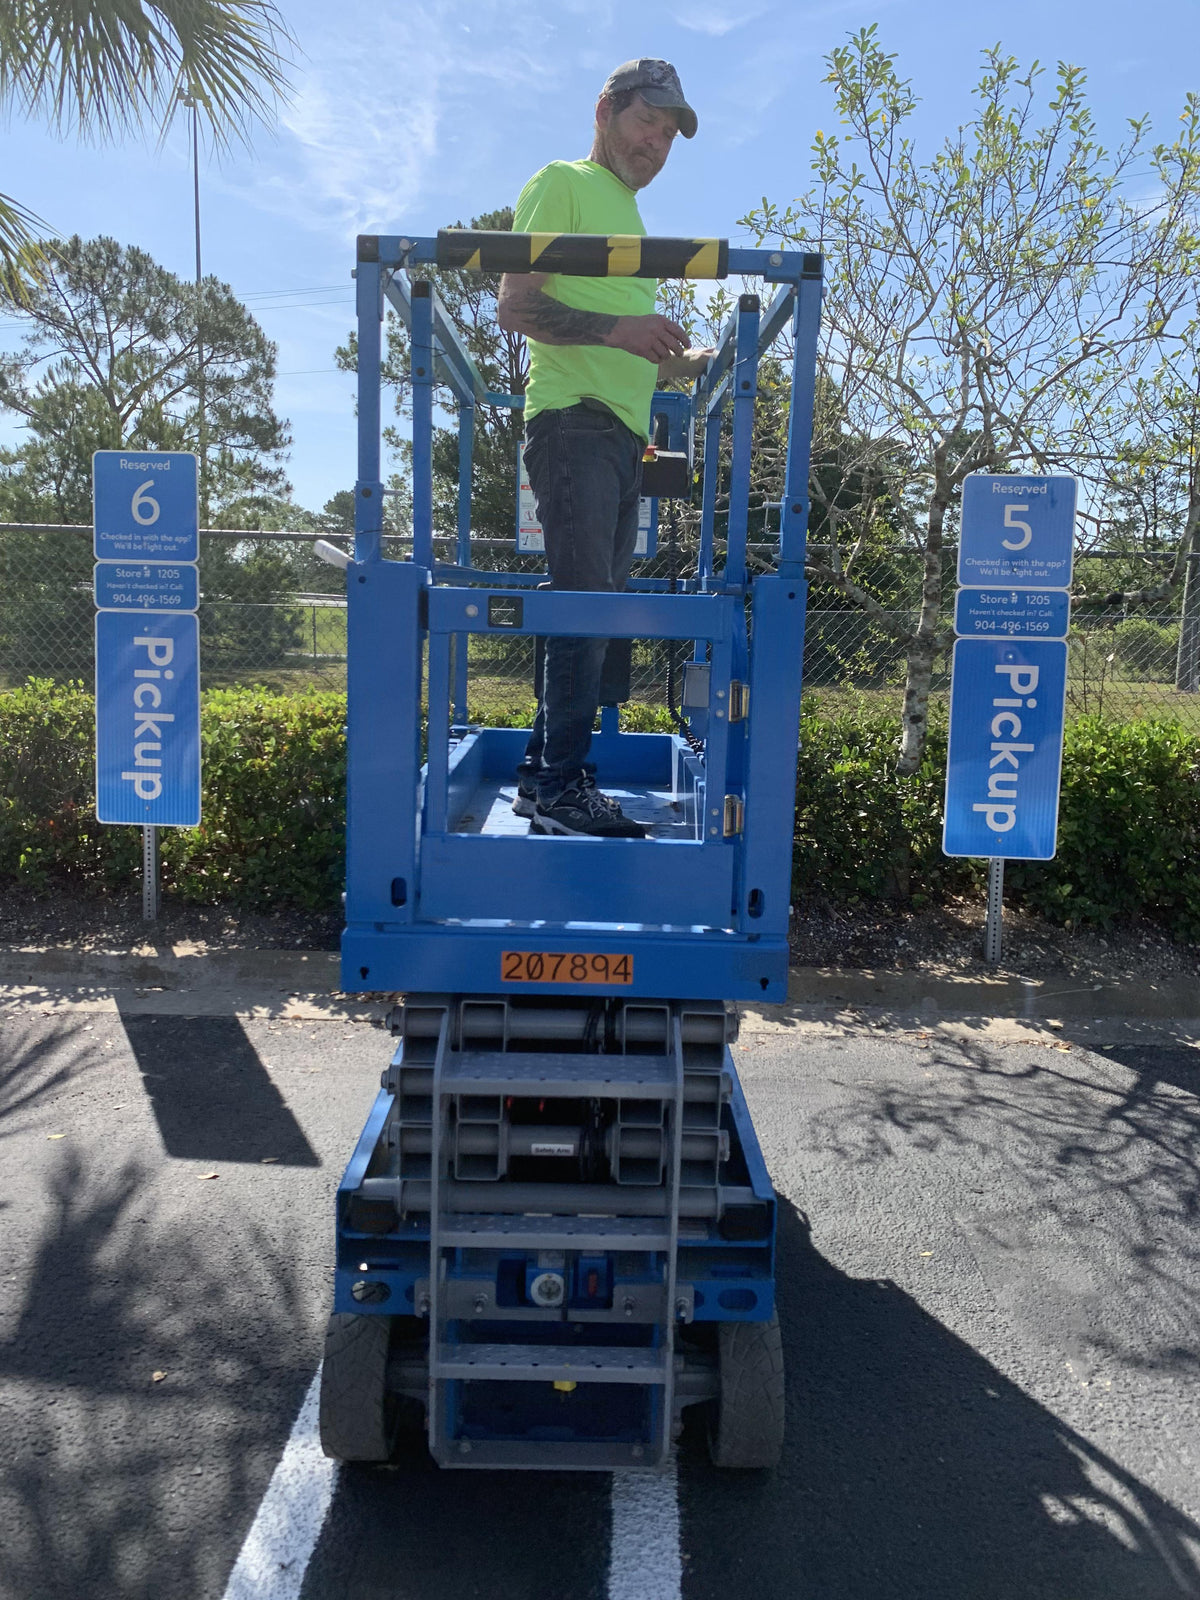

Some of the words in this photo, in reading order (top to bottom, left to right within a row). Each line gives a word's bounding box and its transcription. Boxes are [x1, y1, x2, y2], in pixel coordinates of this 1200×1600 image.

[120, 459, 170, 471] Reserved
[992, 482, 1048, 495] Reserved
[131, 479, 160, 526] 6
[1001, 504, 1033, 551] 5
[101, 532, 132, 541] Checked
[134, 533, 141, 541] in
[142, 533, 159, 542] with
[160, 534, 173, 542] the
[175, 535, 192, 544] app?
[113, 542, 131, 550] We'll
[133, 543, 141, 551] be
[965, 558, 1000, 567] Checked
[1002, 558, 1010, 566] in
[1011, 559, 1029, 567] with
[1031, 559, 1045, 567] the
[1046, 560, 1067, 569] app?
[115, 568, 142, 578] Store
[157, 569, 180, 579] 1205
[980, 567, 999, 576] We'll
[1001, 568, 1011, 576] be
[112, 593, 182, 605] 904-496-1569
[980, 593, 1008, 604] Store
[1026, 595, 1050, 605] 1205
[997, 608, 1026, 616] checked
[1027, 609, 1037, 617] in?
[974, 620, 1050, 632] 904-496-1569
[121, 636, 175, 800] Pickup
[972, 664, 1040, 833] Pickup
[503, 952, 632, 983] 207894
[534, 1146, 556, 1154] Safety
